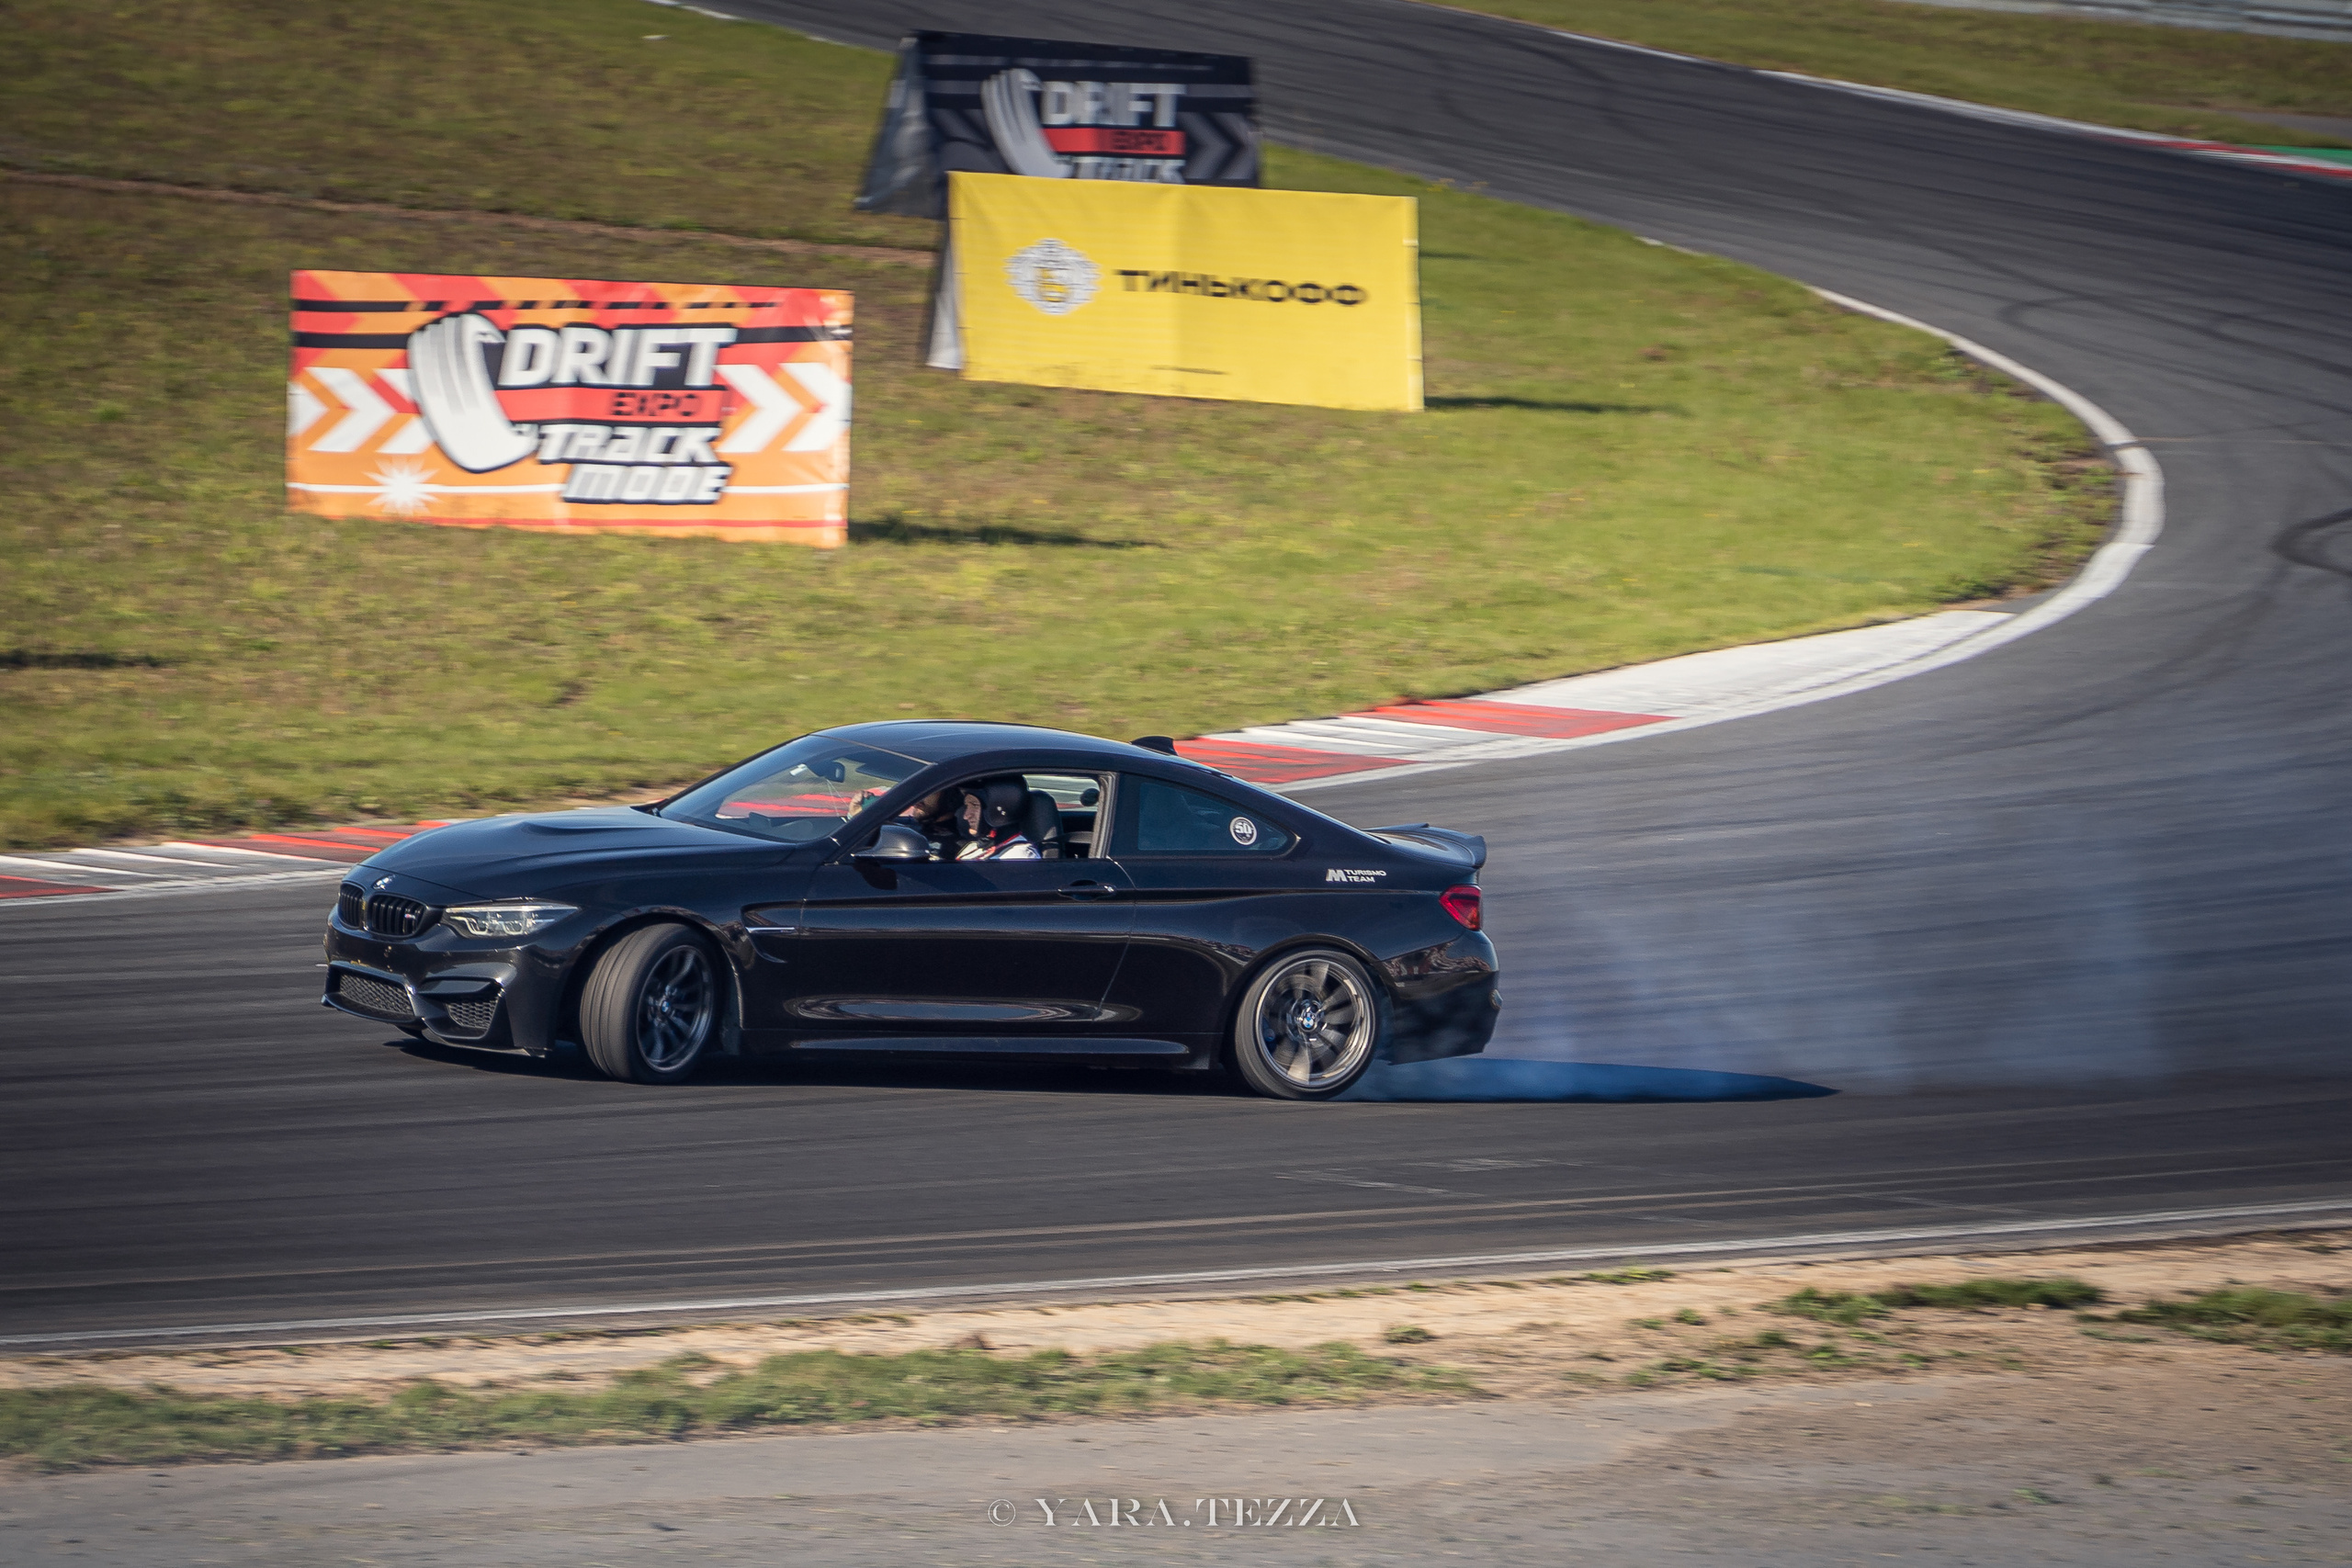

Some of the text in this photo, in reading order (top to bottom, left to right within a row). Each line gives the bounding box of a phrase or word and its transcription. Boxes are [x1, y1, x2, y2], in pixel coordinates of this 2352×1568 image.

[1041, 81, 1186, 127] DRIFT
[1111, 268, 1368, 306] ТИНЬКОФФ
[497, 327, 737, 387] DRIFT
[611, 391, 705, 417] EXPO
